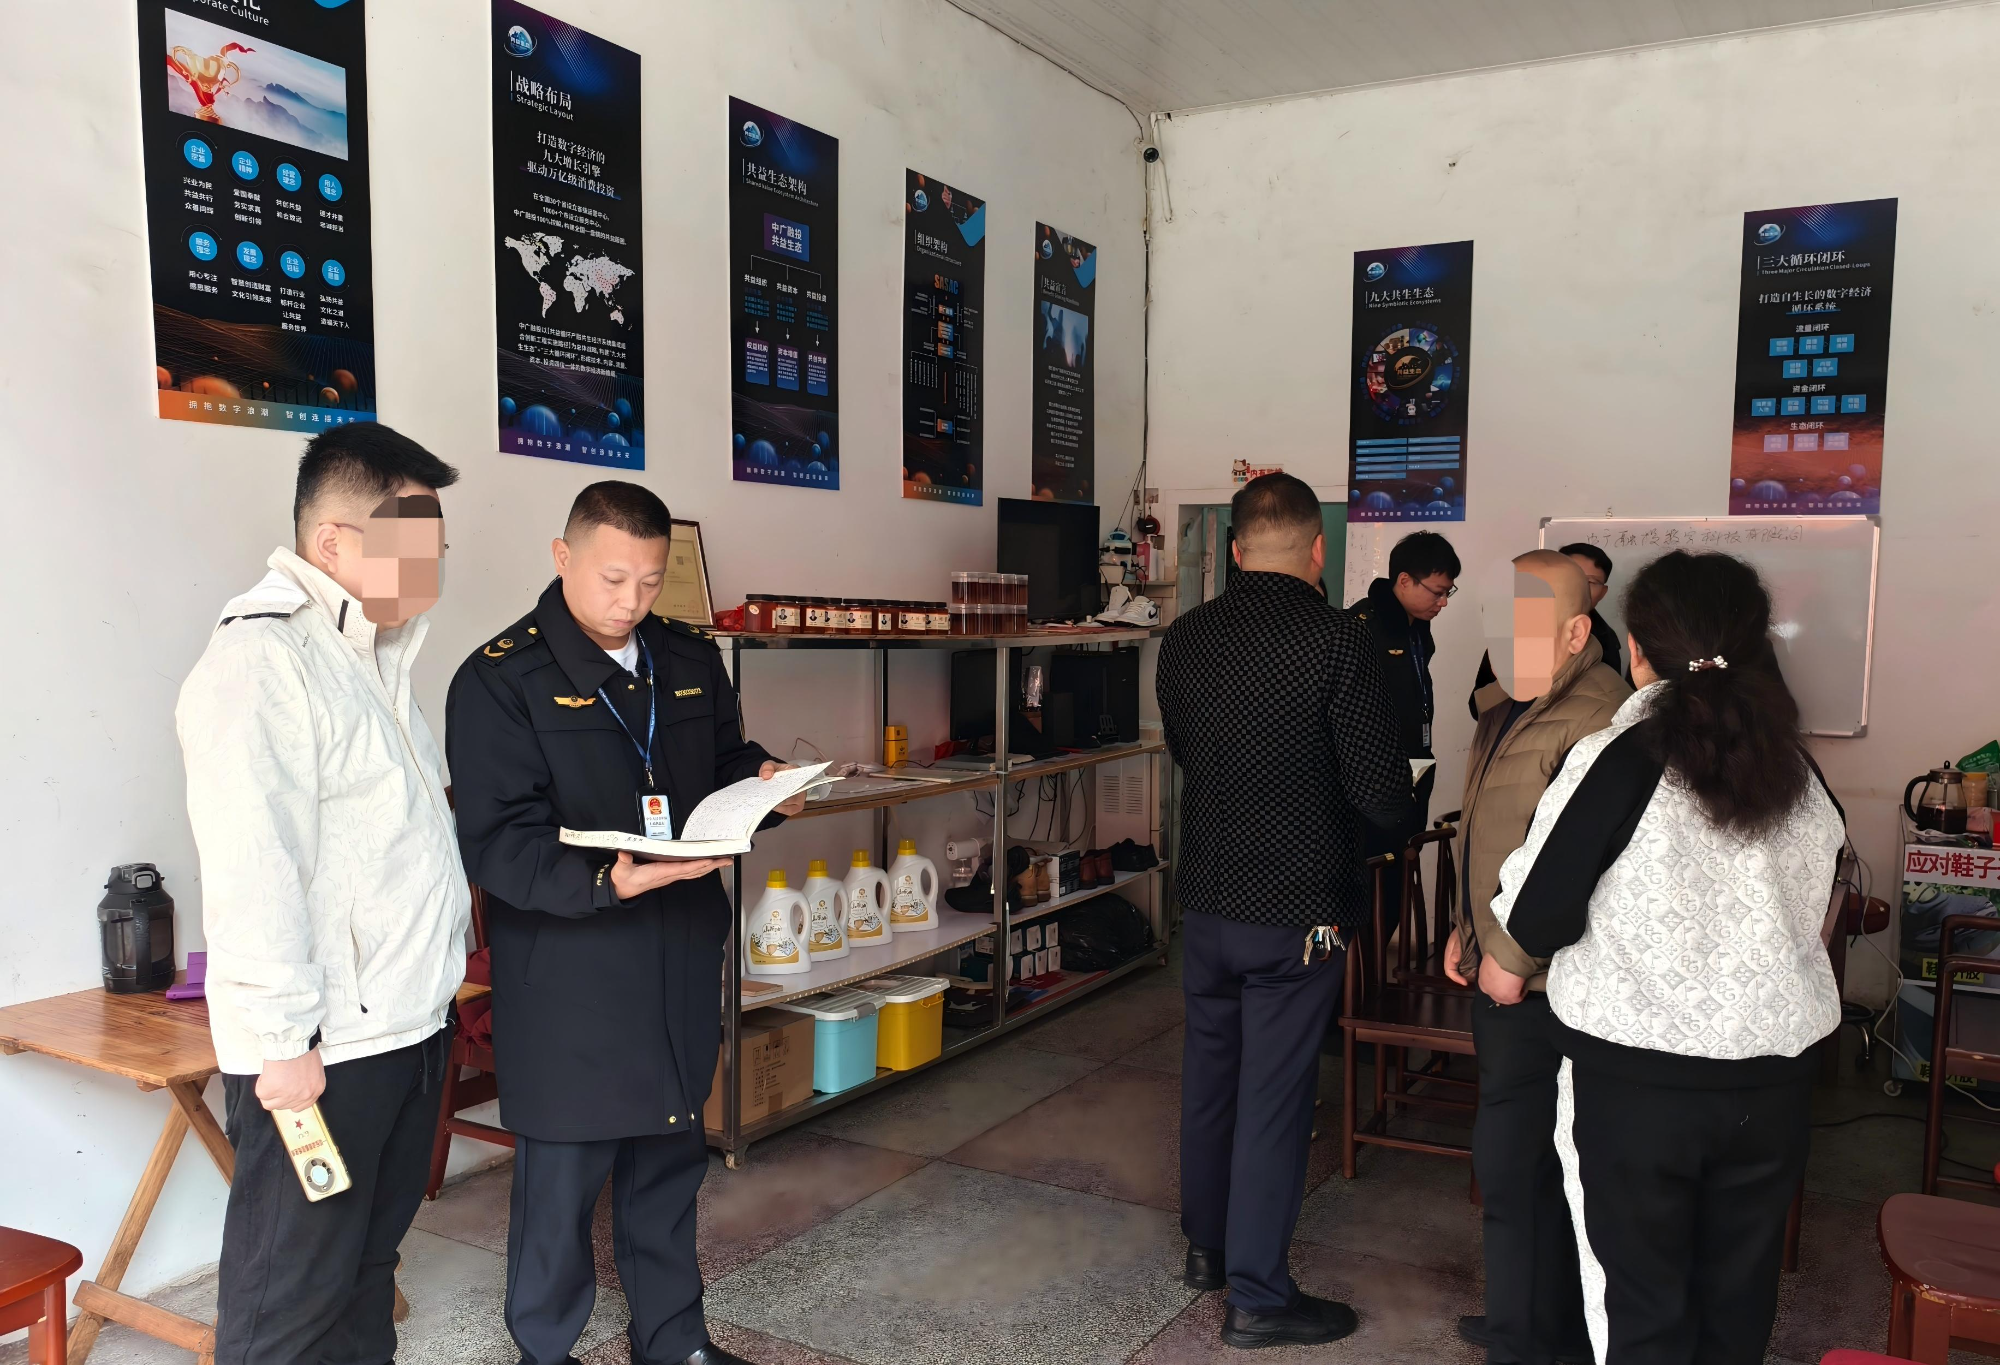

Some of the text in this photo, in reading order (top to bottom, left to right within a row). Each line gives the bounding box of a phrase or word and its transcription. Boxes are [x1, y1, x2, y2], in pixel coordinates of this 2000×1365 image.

[231, 5, 269, 25] Culture
[516, 75, 572, 111] 战略布局
[516, 94, 574, 121] Strategic Layout
[537, 130, 605, 164] 打造数字经济的
[543, 149, 601, 177] 九大增长引擎
[527, 160, 615, 198] 驱动万亿级消费投资
[747, 162, 807, 195] 共益生态架构
[771, 222, 802, 241] 中广融投
[771, 235, 802, 253] 共益生态
[1762, 250, 1845, 268] 三大循环闭环
[1779, 268, 1796, 276] Major
[934, 274, 958, 295] SASAC
[1370, 287, 1434, 302] 九大共生生态
[1759, 286, 1872, 304] 打造自生长的数字经济
[189, 400, 269, 417] 拥抱数字浪潮
[1906, 850, 2000, 881] 应对鞋子
